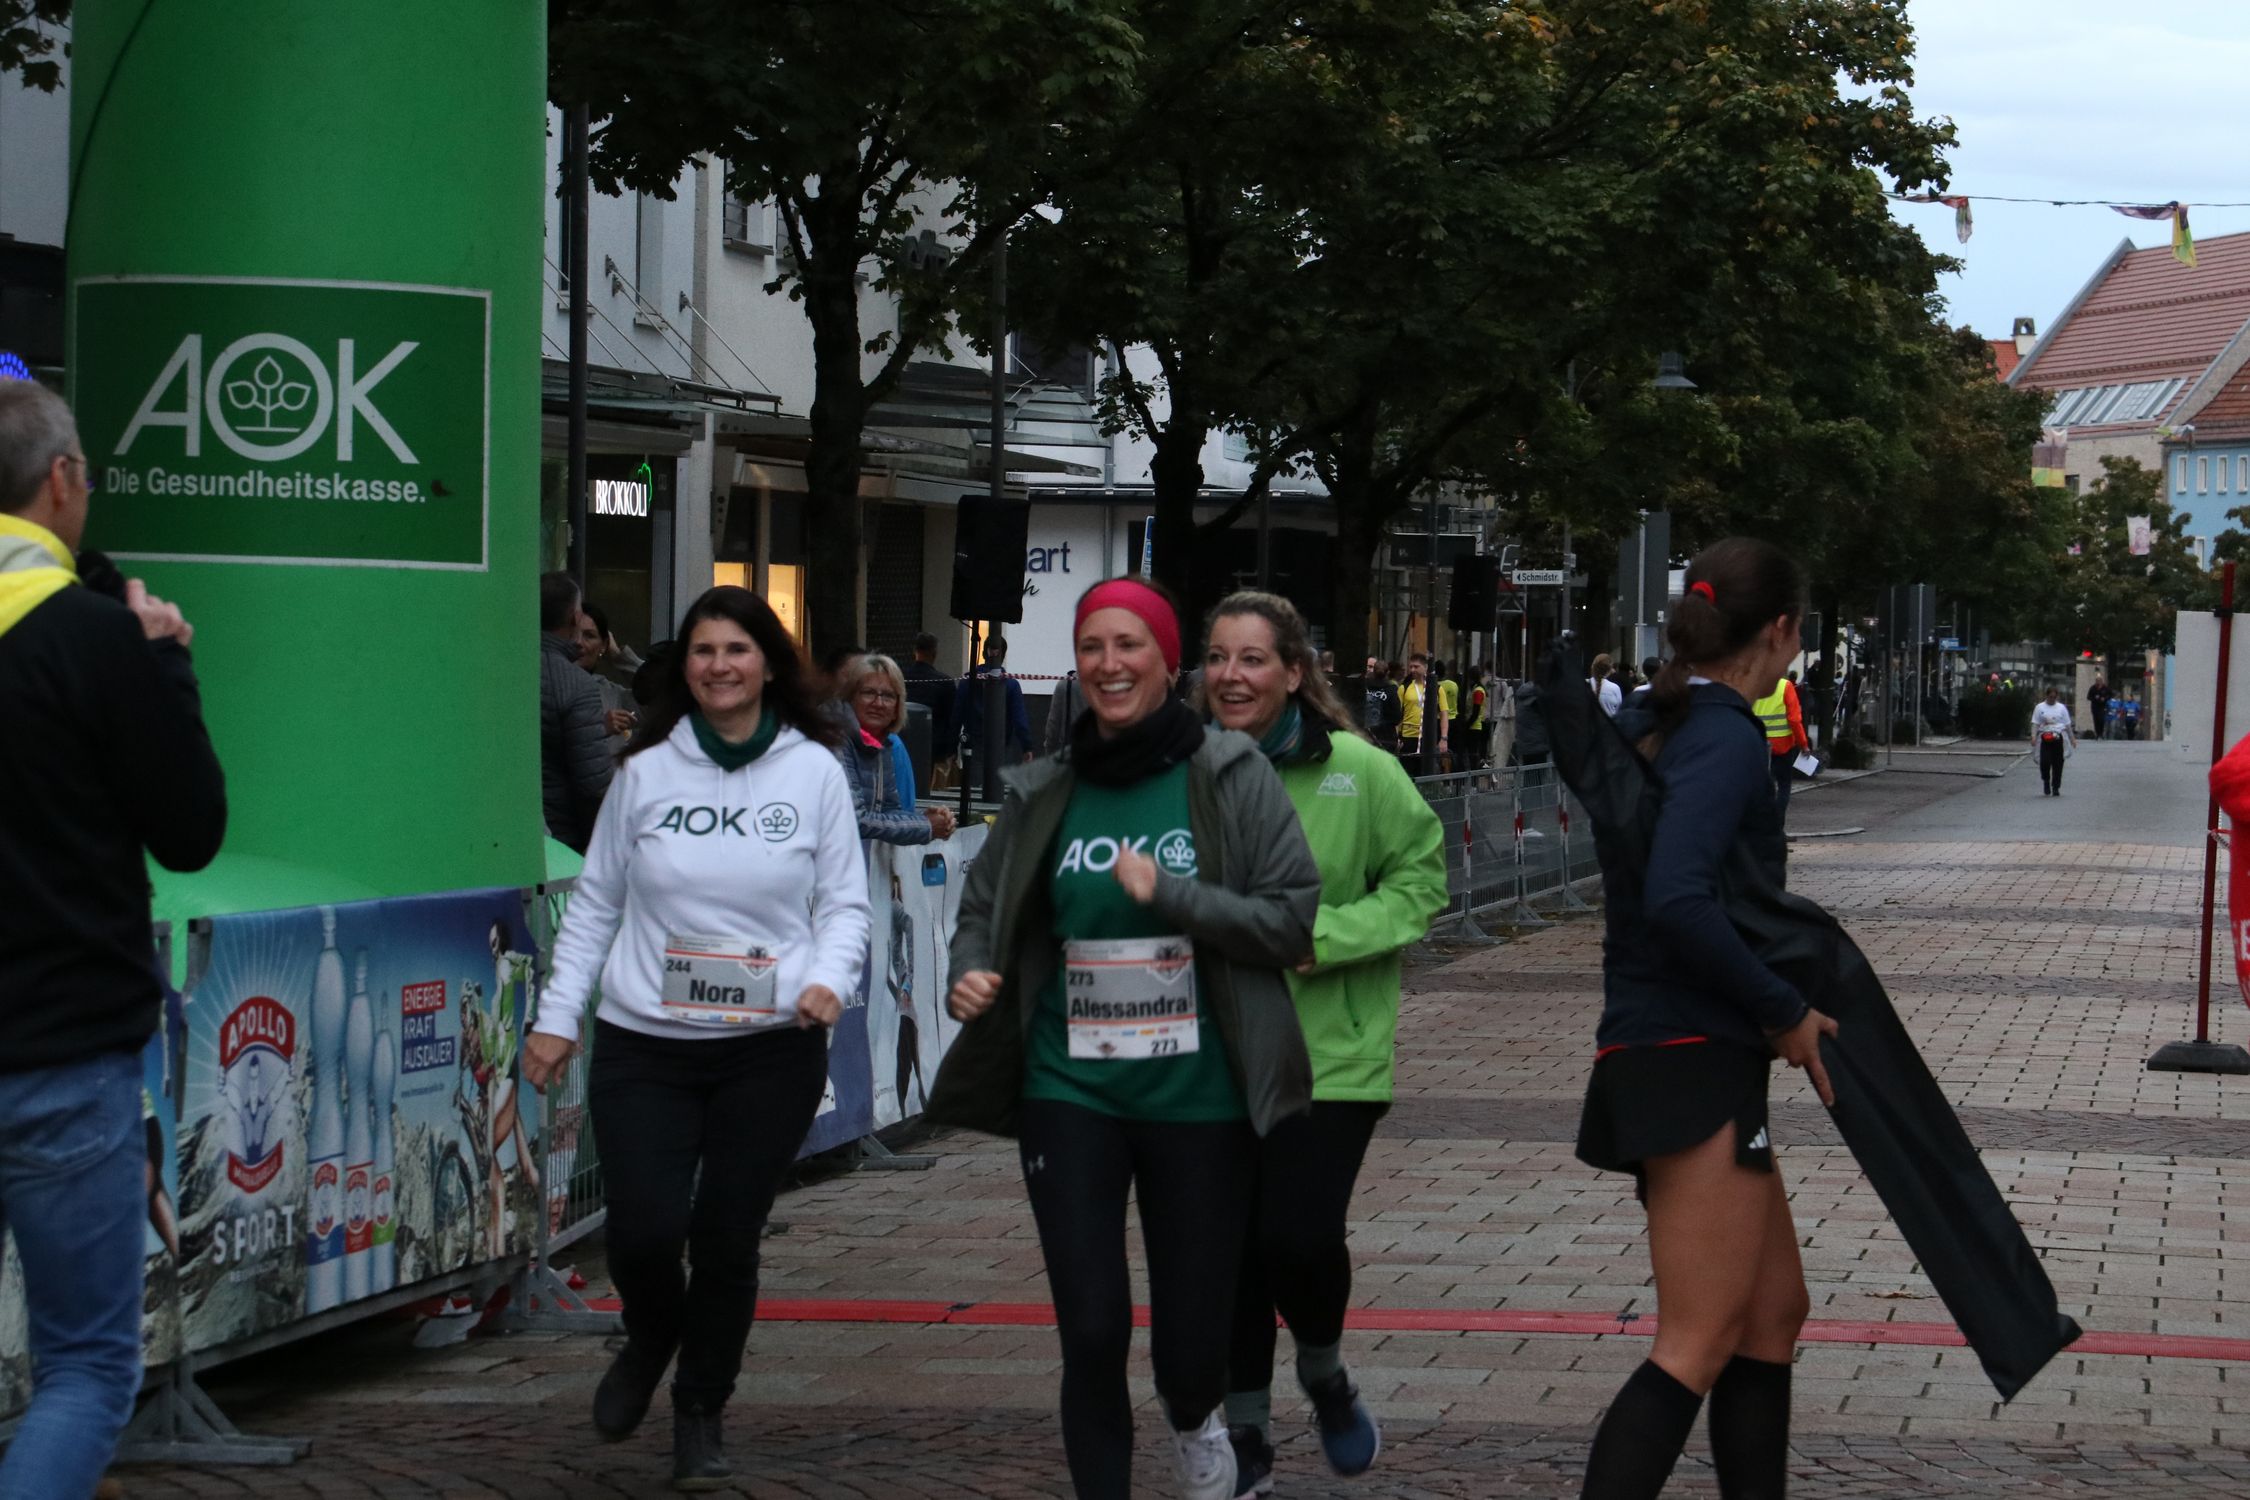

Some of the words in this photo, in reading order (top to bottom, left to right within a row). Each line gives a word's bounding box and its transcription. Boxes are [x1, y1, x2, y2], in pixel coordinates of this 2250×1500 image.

[113, 332, 420, 464] AOK
[106, 467, 139, 495] Die
[147, 467, 426, 503] Gesundheitskasse.
[595, 480, 647, 517] BROKKOLI
[1024, 541, 1071, 573] art
[1521, 572, 1559, 583] Schmidstr.
[1318, 772, 1357, 791] AOK
[653, 806, 748, 837] AOK
[666, 960, 692, 973] 244
[1069, 971, 1094, 986] 273
[404, 985, 443, 1011] ENERGIE
[689, 979, 745, 1004] Nora
[1071, 996, 1188, 1018] Alessandra
[227, 1005, 287, 1052] APOLLO
[404, 1014, 434, 1041] KRAFT
[404, 1040, 453, 1069] AUSDAUER
[1151, 1038, 1179, 1056] 273
[212, 1205, 295, 1264] SPORT
